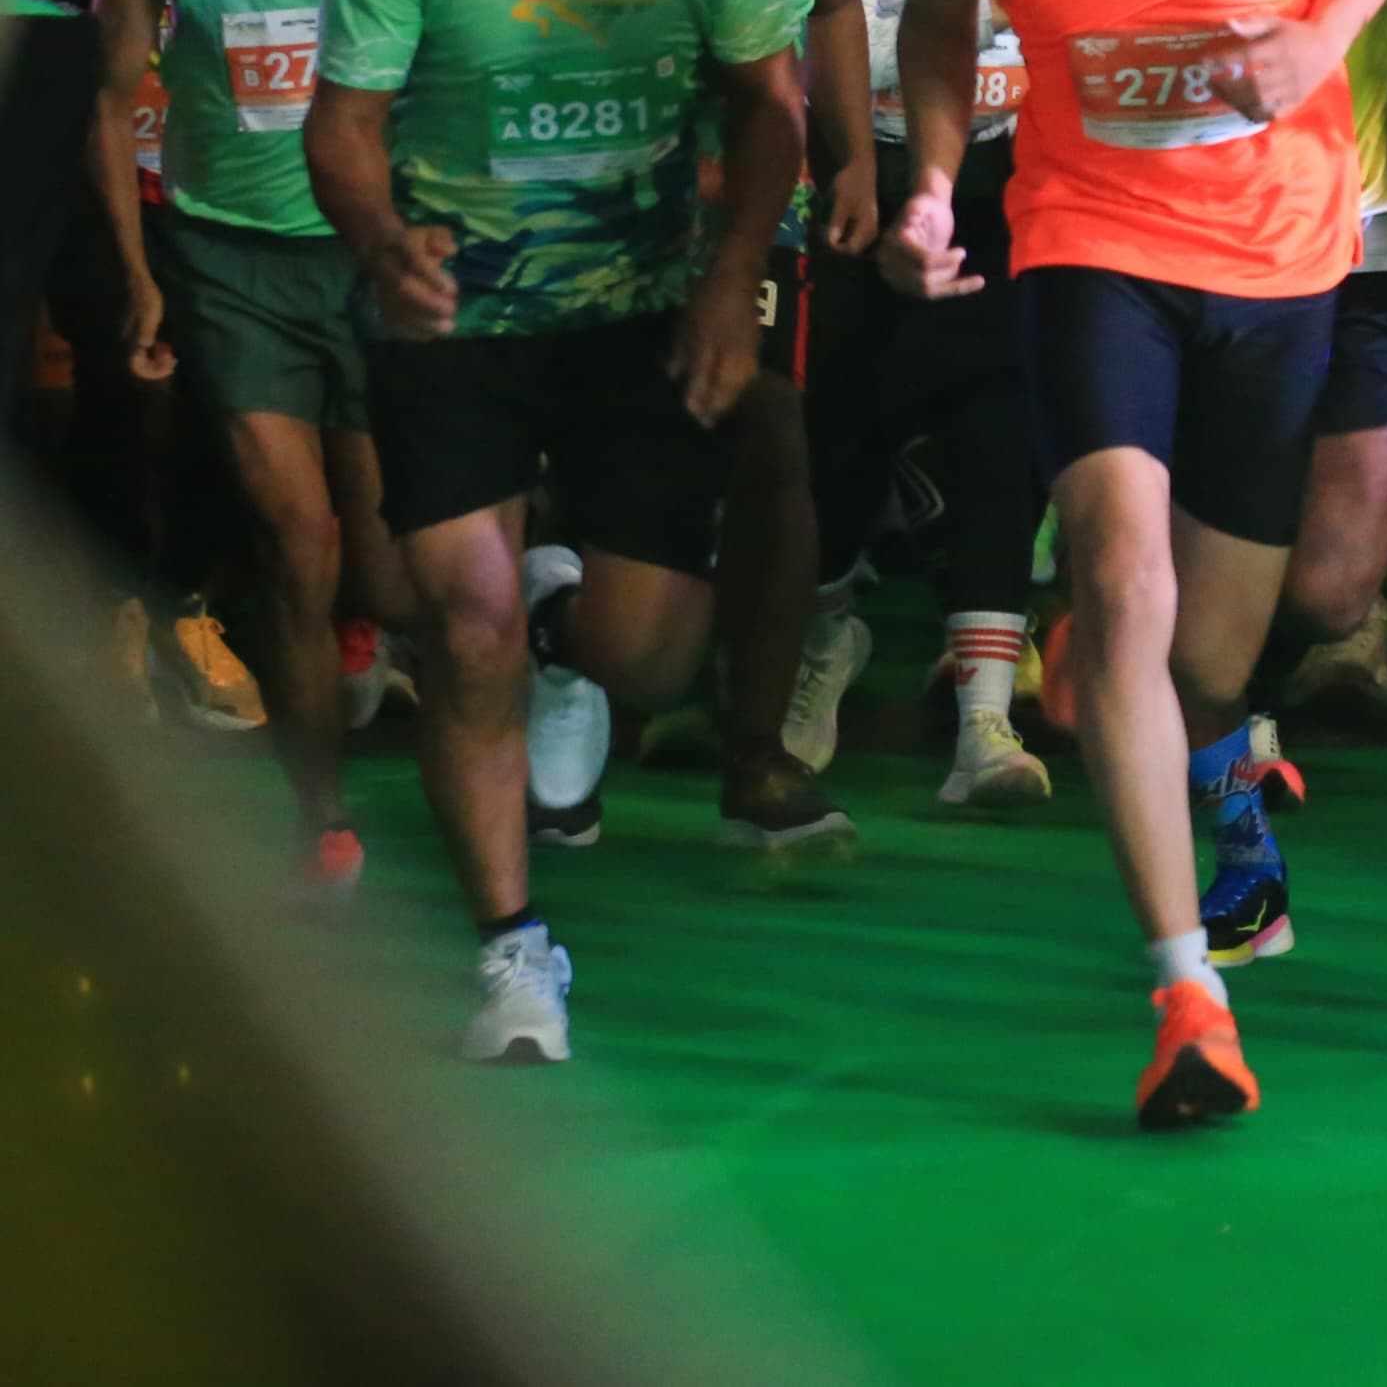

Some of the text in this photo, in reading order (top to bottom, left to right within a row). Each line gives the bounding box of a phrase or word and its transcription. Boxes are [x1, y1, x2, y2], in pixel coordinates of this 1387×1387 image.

[244, 48, 318, 91] B 27
[1113, 65, 1212, 107] 278
[502, 121, 522, 141] A
[530, 95, 648, 141] 8281
